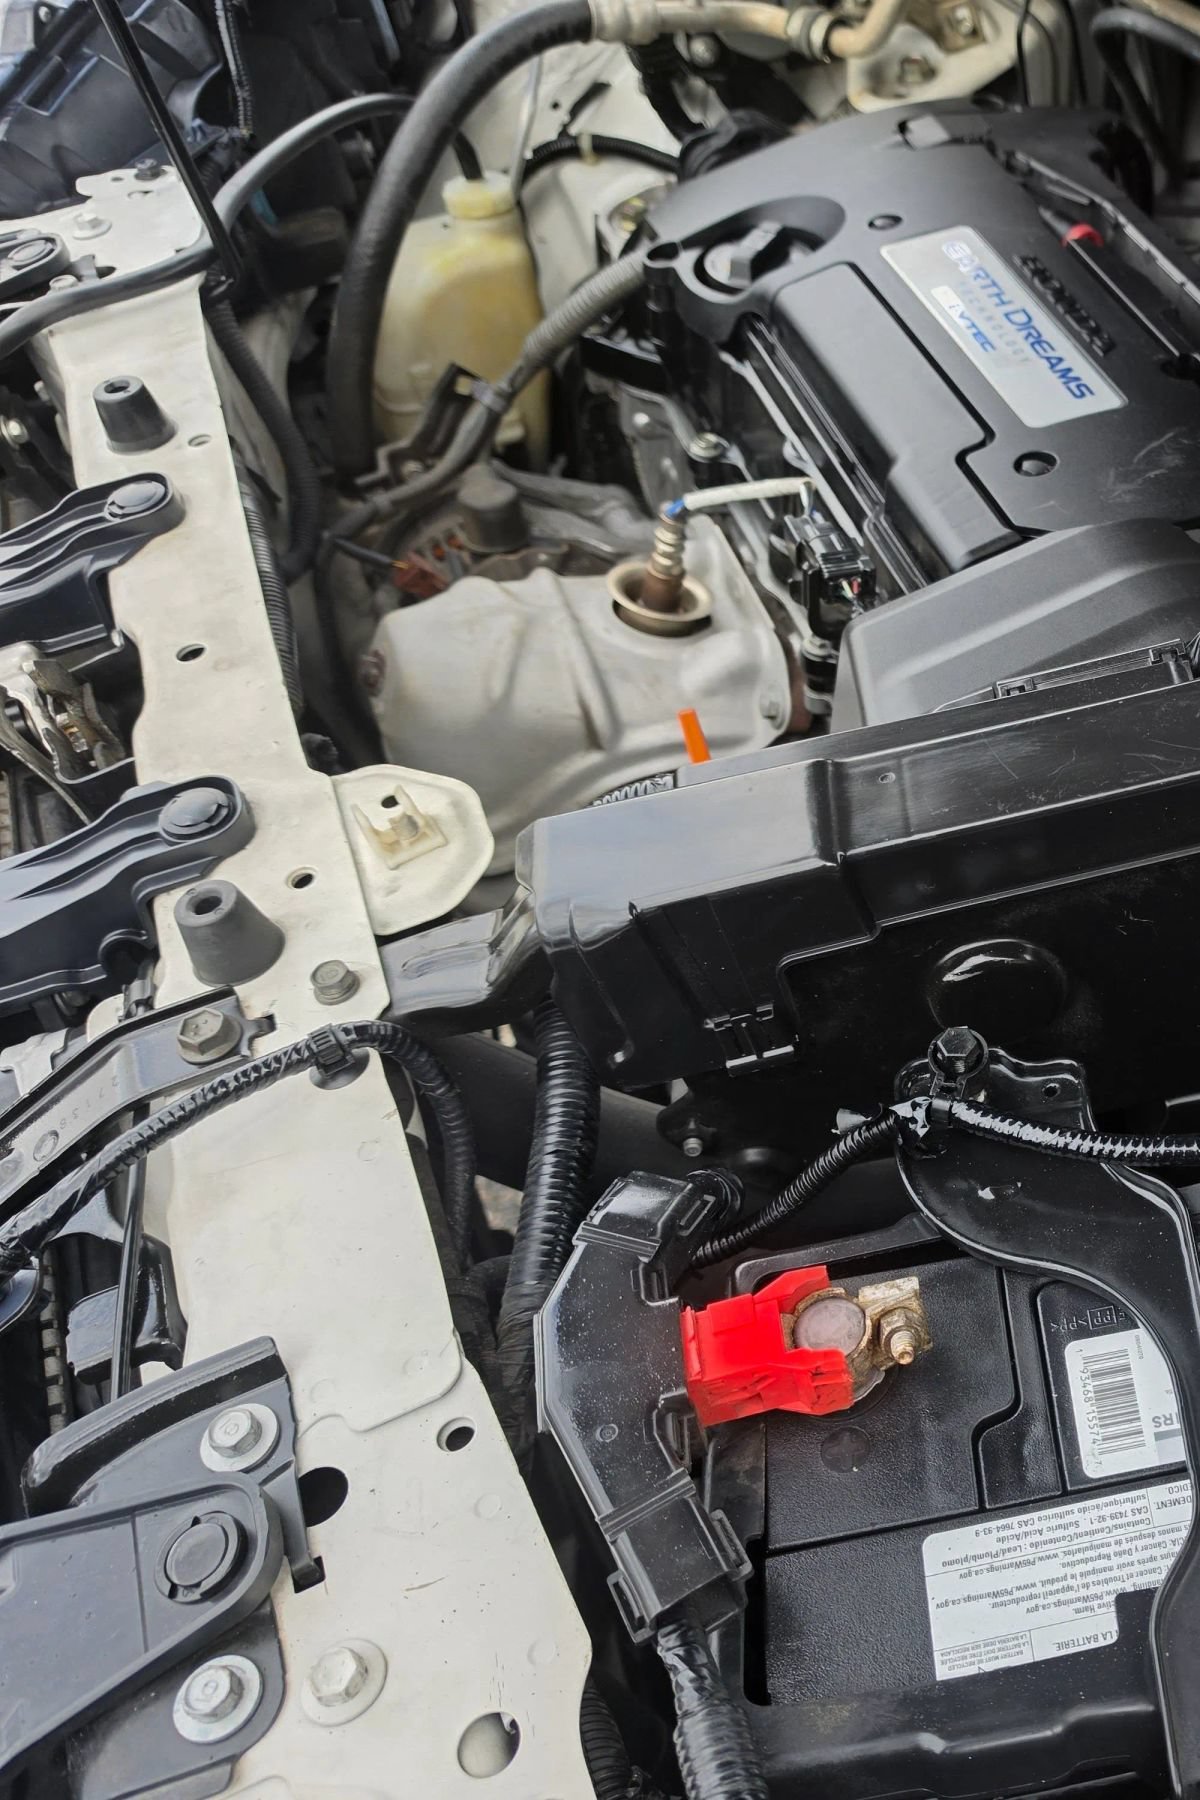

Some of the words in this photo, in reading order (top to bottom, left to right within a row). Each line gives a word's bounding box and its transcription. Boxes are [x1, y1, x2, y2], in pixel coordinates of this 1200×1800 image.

[1003, 307, 1095, 400] DREAMS
[1079, 1367, 1093, 1403] 93468
[1085, 1409, 1100, 1444] 15574
[1089, 1509, 1128, 1524] 7439-92-1
[1130, 1505, 1148, 1516] CAS
[1017, 1517, 1034, 1528] CAS
[1046, 1520, 1080, 1533] Sulfuric
[974, 1522, 1014, 1537] 7664-93-9
[996, 1527, 1043, 1544] Acid/Acide
[1029, 1517, 1151, 1549] Contains/Contient/Contenido
[1157, 1526, 1182, 1536] manos
[1113, 1538, 1123, 1546] de
[1124, 1531, 1156, 1544] después
[1113, 1547, 1133, 1558] Daño
[1134, 1544, 1139, 1552] y
[941, 1544, 1022, 1567] Lead/Plomb/plomo
[1059, 1552, 1111, 1568] Reproductivo.
[1136, 1554, 1157, 1566] après
[958, 1552, 1059, 1579] www.P65Warnings.ca.gov
[1116, 1560, 1135, 1570] avoir
[1070, 1572, 1077, 1581] le
[1079, 1565, 1114, 1580] manipulé
[1126, 1572, 1134, 1580] et
[1135, 1566, 1162, 1577] Cancer
[1080, 1581, 1090, 1590] de
[1091, 1574, 1126, 1587] Troubles
[935, 1581, 1037, 1609] www.P65Warnings.ca.gov
[1042, 1583, 1079, 1600] l'appareil
[988, 1591, 1041, 1608] reproducteur.
[1072, 1604, 1095, 1614] Harm.
[1100, 1630, 1112, 1640] LA
[997, 1642, 1021, 1652] BATTERIE
[1000, 1649, 1023, 1659] BATTERY
[947, 1660, 975, 1671] RECYCLED
